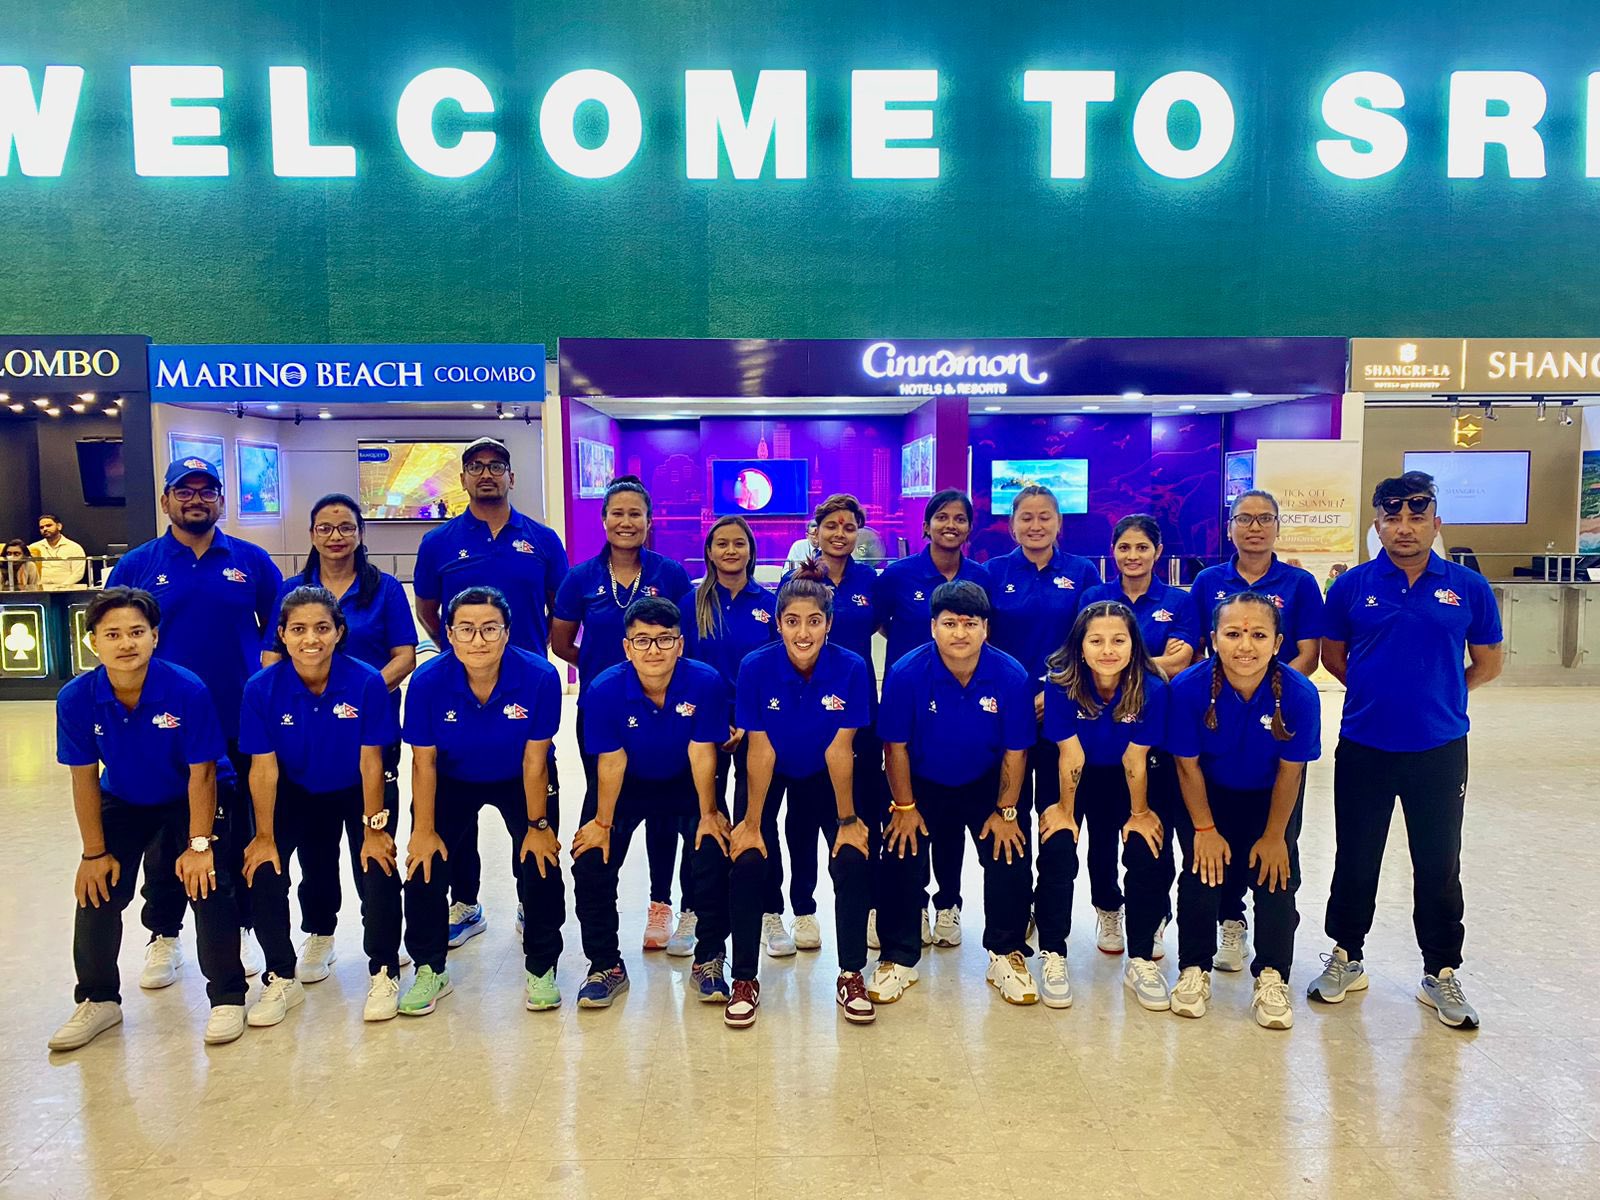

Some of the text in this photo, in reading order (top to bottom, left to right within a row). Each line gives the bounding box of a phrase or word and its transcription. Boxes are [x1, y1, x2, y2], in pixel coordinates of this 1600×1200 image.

[0, 65, 941, 180] WELCOME
[1023, 70, 1236, 180] TO
[0, 349, 120, 377] OMBO
[155, 359, 536, 388] MARINO BEACH COLOMBO
[862, 342, 1048, 385] Cinnamon
[1364, 364, 1450, 377] SHANGRI-LA
[899, 383, 1007, 395] HOTELS & RESORTS
[1283, 488, 1304, 497] TICK
